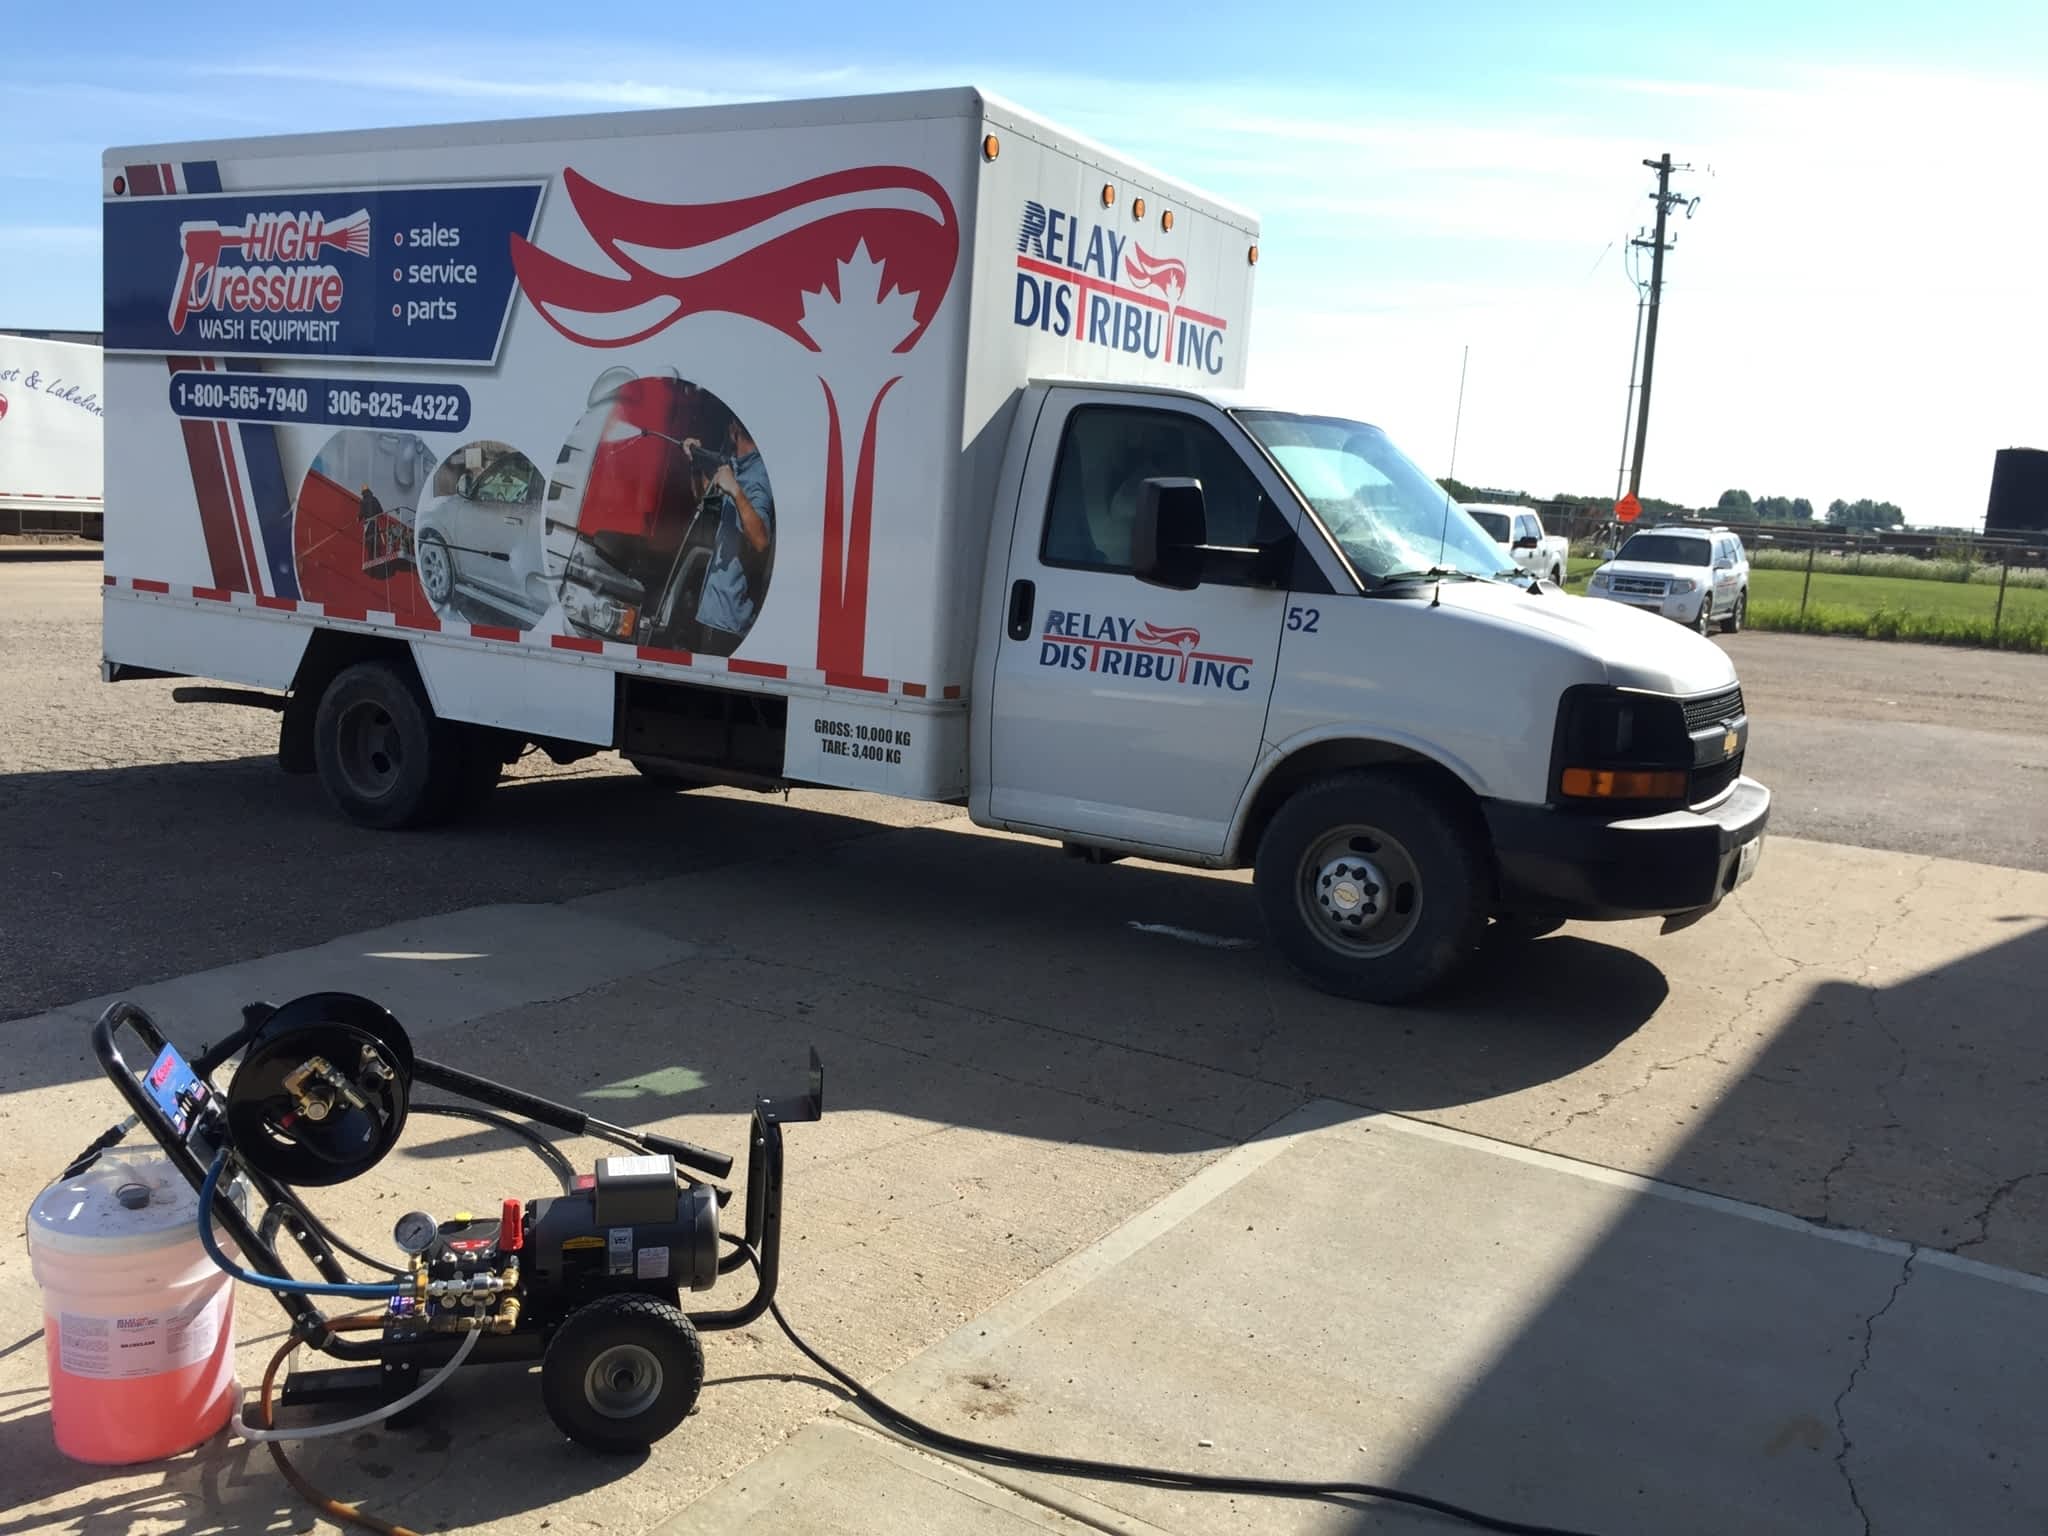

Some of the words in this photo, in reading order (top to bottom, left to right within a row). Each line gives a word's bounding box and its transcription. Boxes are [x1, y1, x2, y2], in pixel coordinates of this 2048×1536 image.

[243, 211, 325, 262] HIGH
[409, 222, 460, 248] sales
[1016, 200, 1126, 281] RELAY
[408, 259, 478, 285] service
[407, 299, 457, 326] parts
[1014, 270, 1226, 375] DISTRIBUTING
[200, 319, 244, 340] WASH
[250, 320, 340, 343] EQUIPMENT
[25, 370, 42, 390] &
[178, 383, 308, 413] 1-800-565-7940
[328, 390, 459, 421] 306-825-4322
[1044, 610, 1137, 642] RELAY
[1287, 607, 1320, 633] 52
[1040, 642, 1252, 691] DISTRIBUTING
[814, 719, 853, 738] GROSS:
[855, 725, 893, 744] 10,000
[895, 730, 911, 746] KG
[822, 739, 850, 756] TARE:
[852, 743, 883, 761] 3,400
[885, 749, 901, 764] KG
